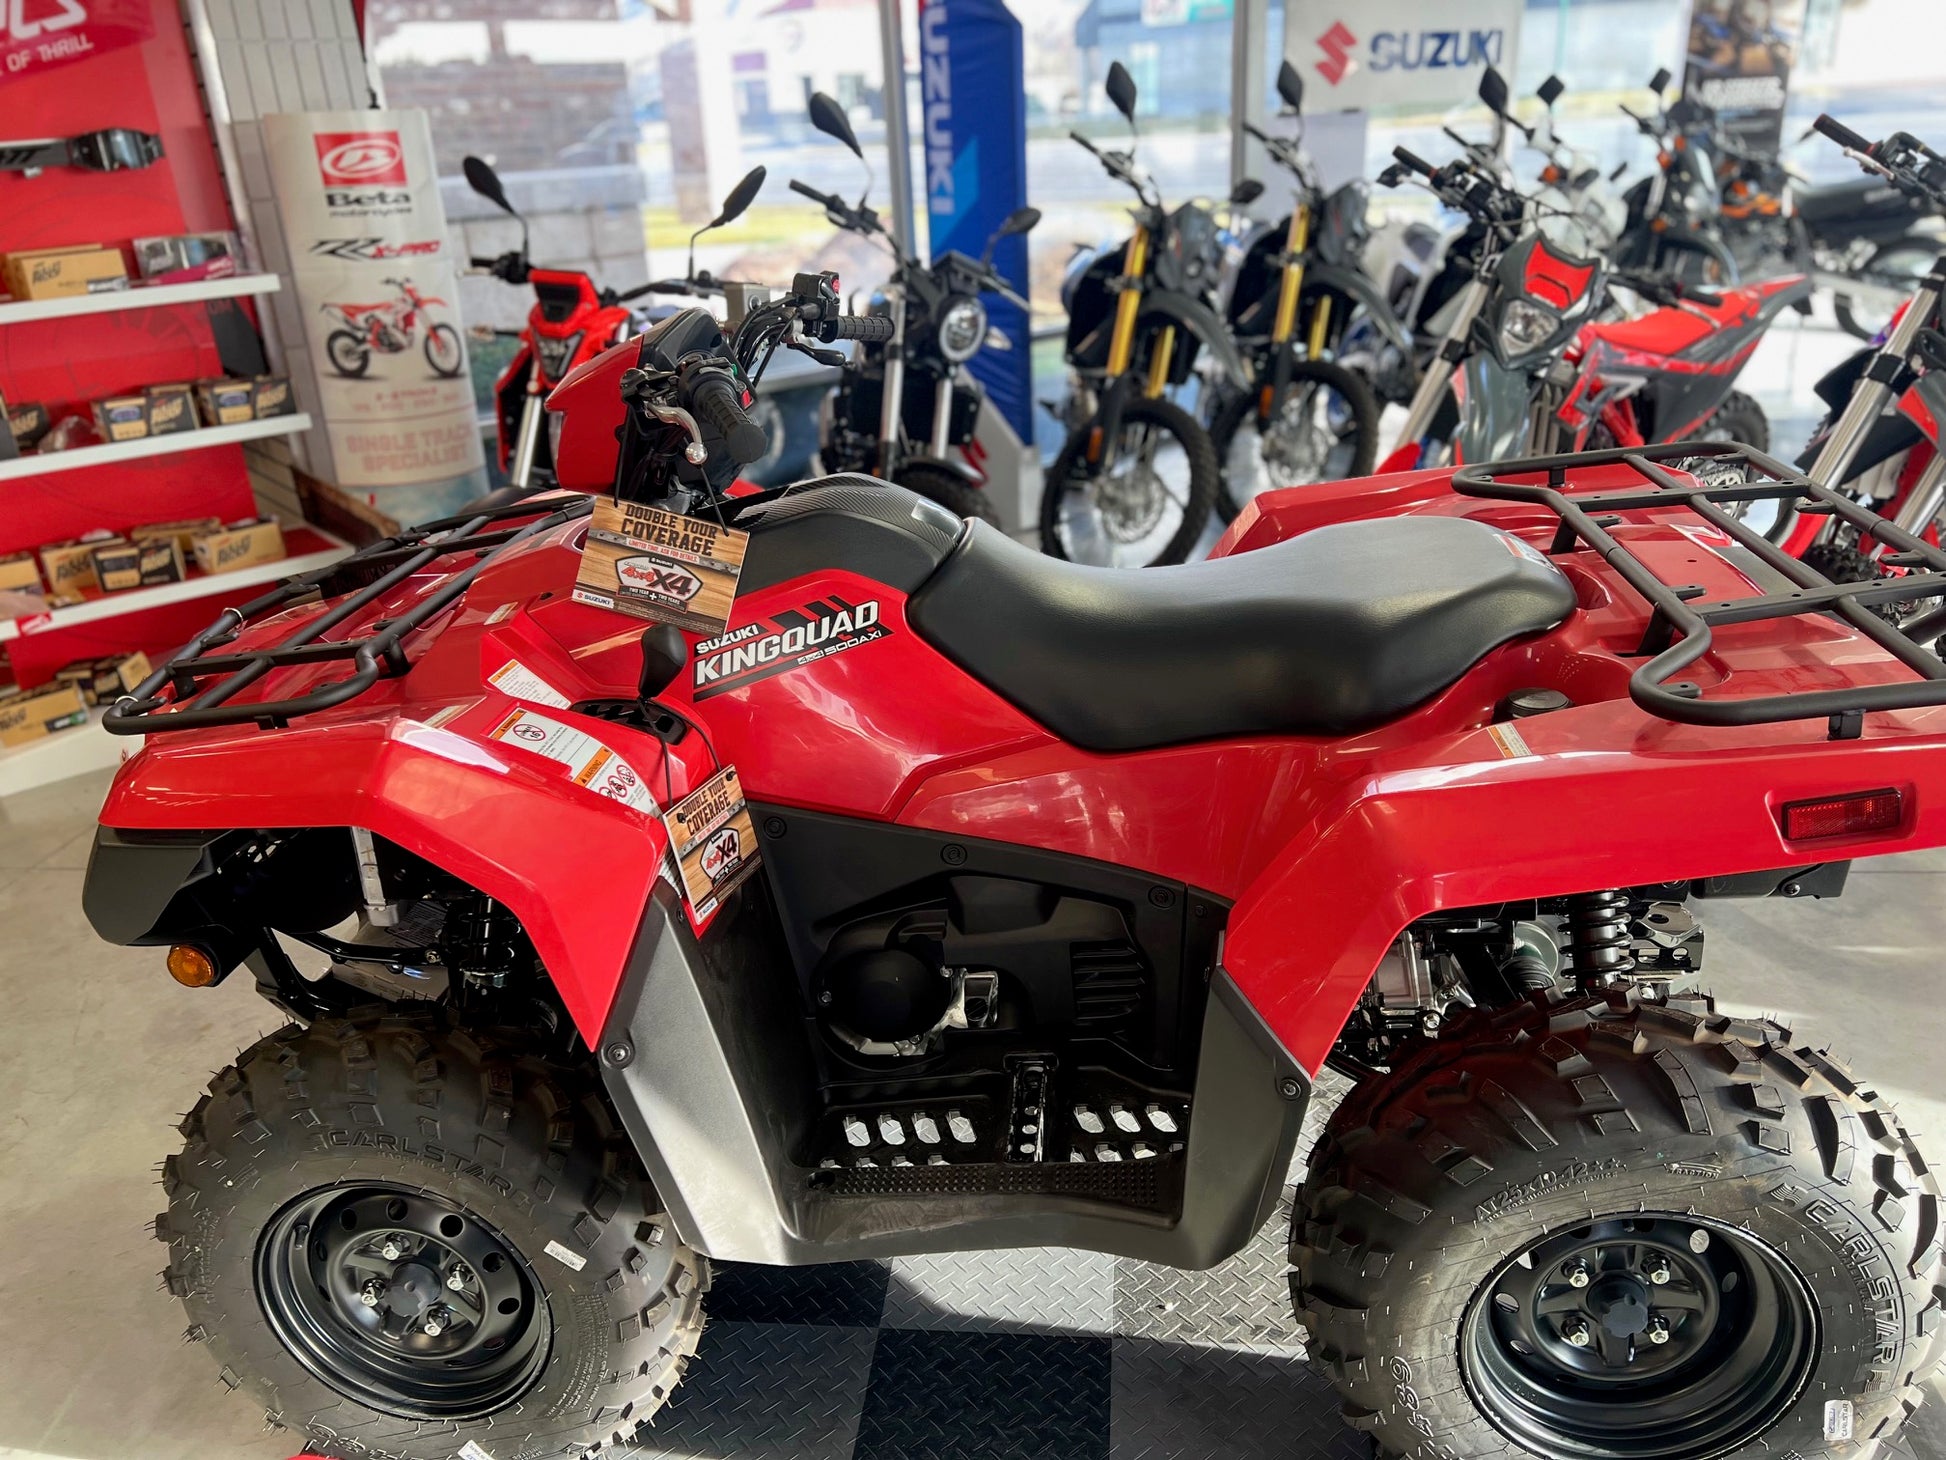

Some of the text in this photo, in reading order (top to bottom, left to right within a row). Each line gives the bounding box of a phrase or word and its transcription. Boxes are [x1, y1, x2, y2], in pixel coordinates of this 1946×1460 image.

[6, 32, 95, 73] OF THRILL
[1368, 28, 1504, 73] SUZUKI
[921, 0, 956, 215] UZUKI
[326, 192, 412, 207] Beta
[621, 517, 715, 557] COVERAGE
[625, 503, 718, 540] DOUBLE YOUR
[584, 594, 611, 606] SUZUKI
[696, 624, 759, 654] SUZUKI
[696, 601, 879, 685] KINGQUAD
[708, 778, 726, 799] YOUR
[686, 790, 732, 836] COVERAGE
[329, 1129, 514, 1197] CARLSTAR
[1667, 1166, 1720, 1180] TRACTION
[1526, 1182, 1571, 1202] HIGHWAY
[1805, 1199, 1900, 1365] CARLSTAR
